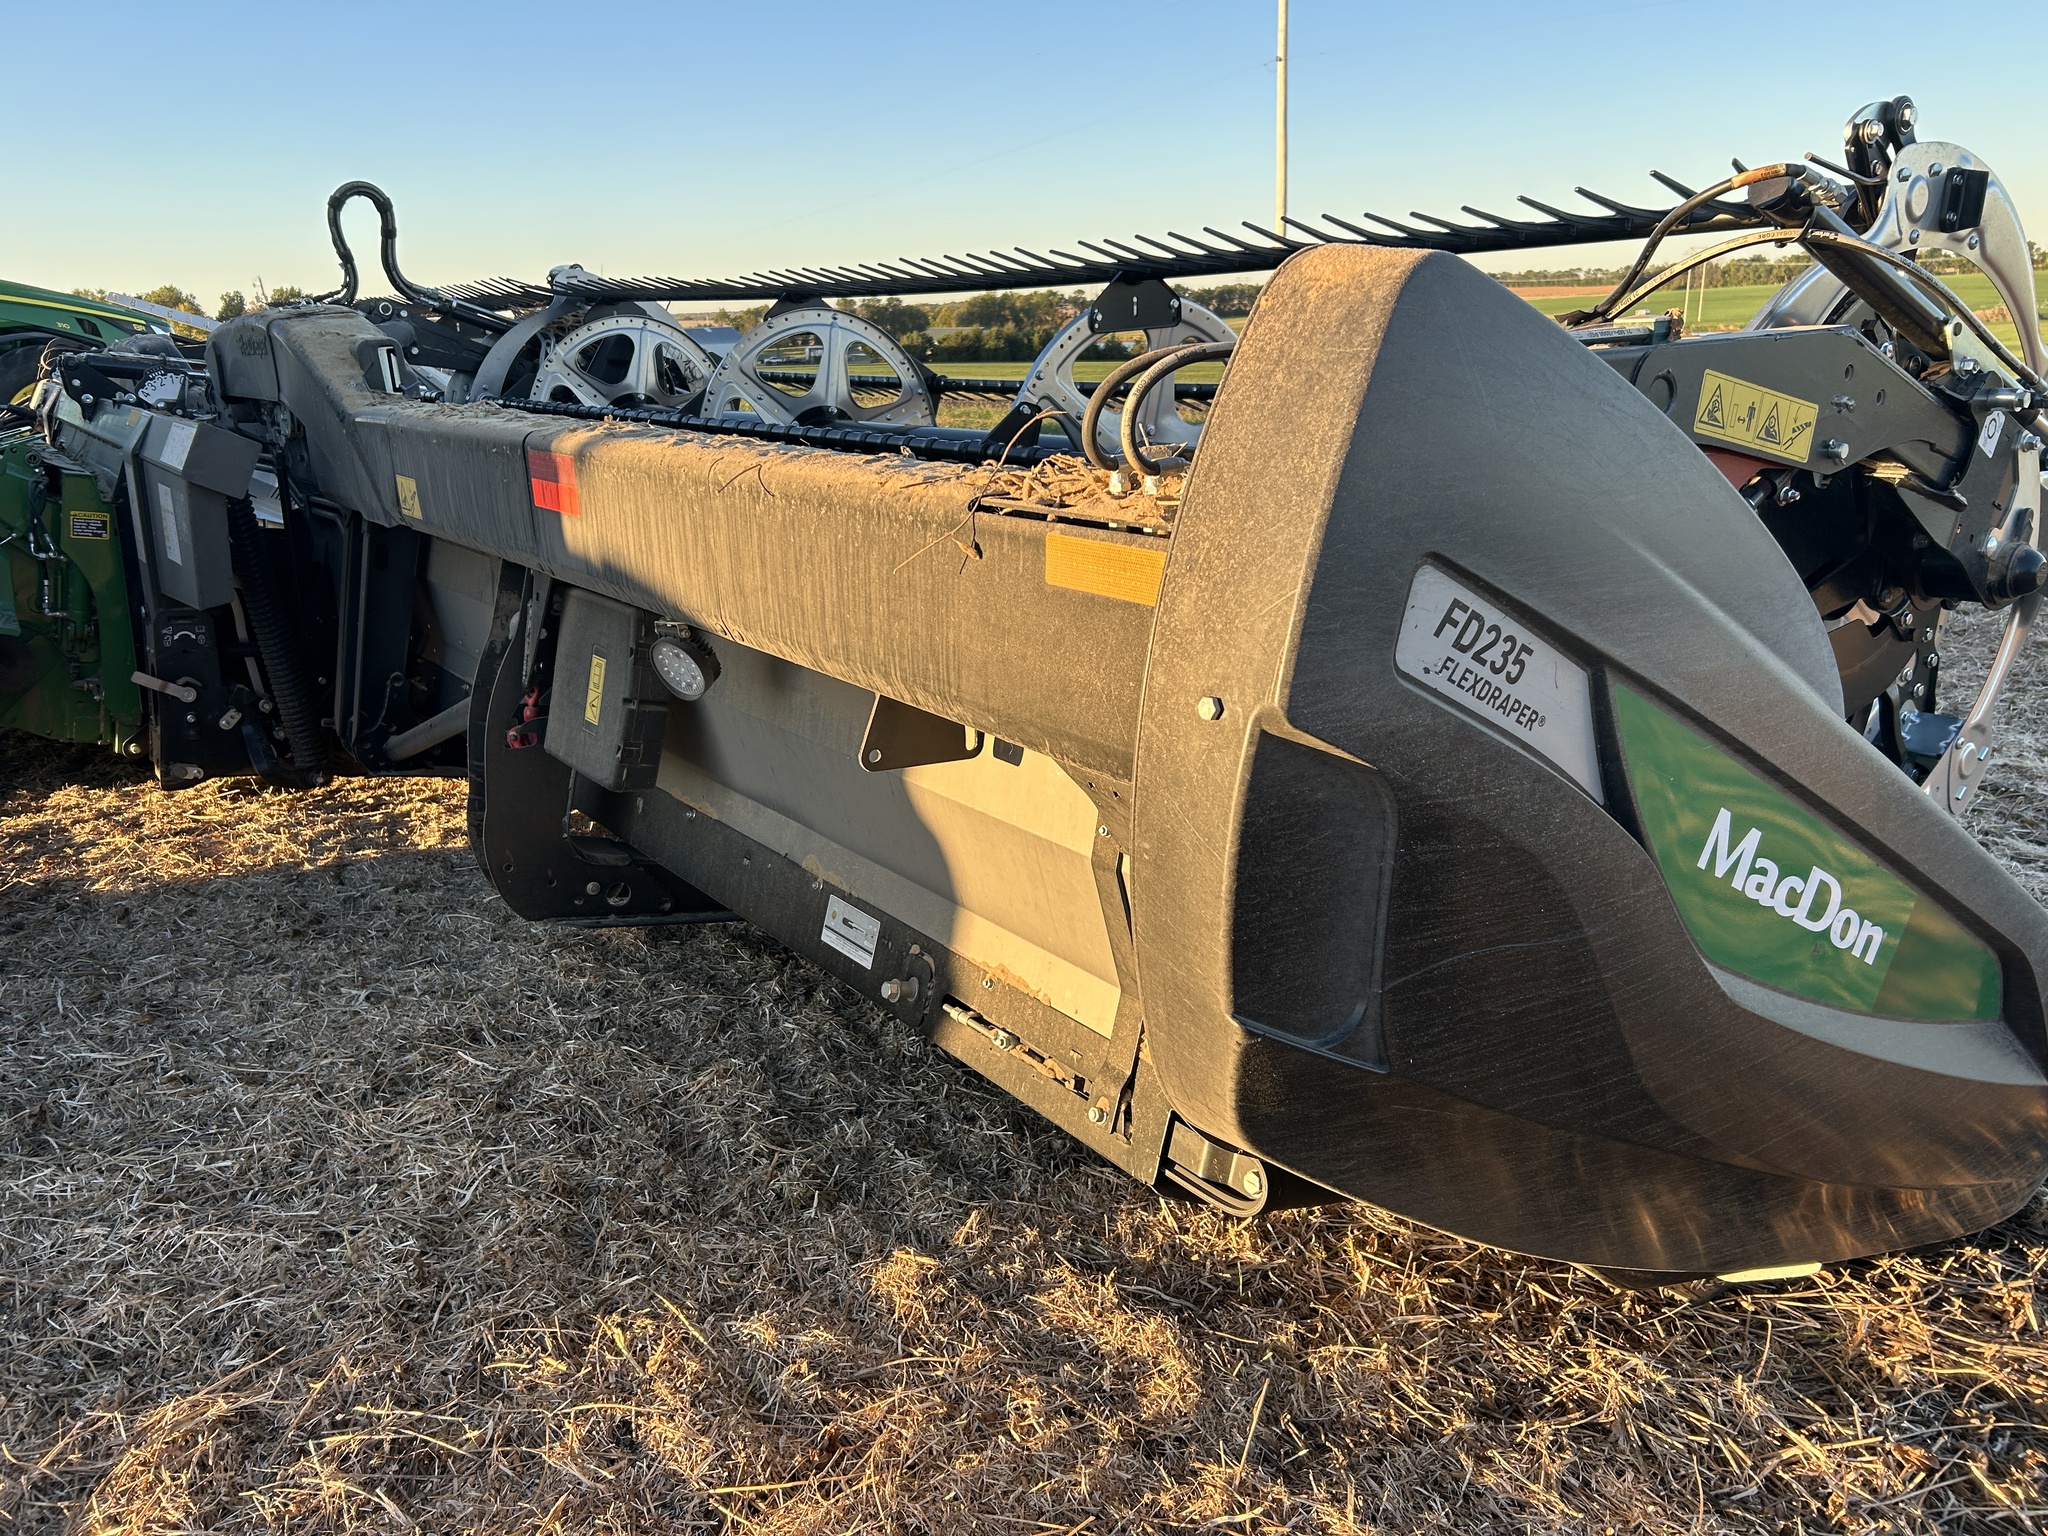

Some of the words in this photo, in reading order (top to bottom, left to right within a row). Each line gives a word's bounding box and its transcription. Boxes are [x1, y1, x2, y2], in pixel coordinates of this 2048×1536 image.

[141, 390, 151, 398] 4
[147, 382, 157, 391] 3
[157, 376, 166, 386] 2
[169, 375, 174, 384] 1
[1433, 597, 1534, 685] FD235
[1697, 807, 1884, 965] MacDon
